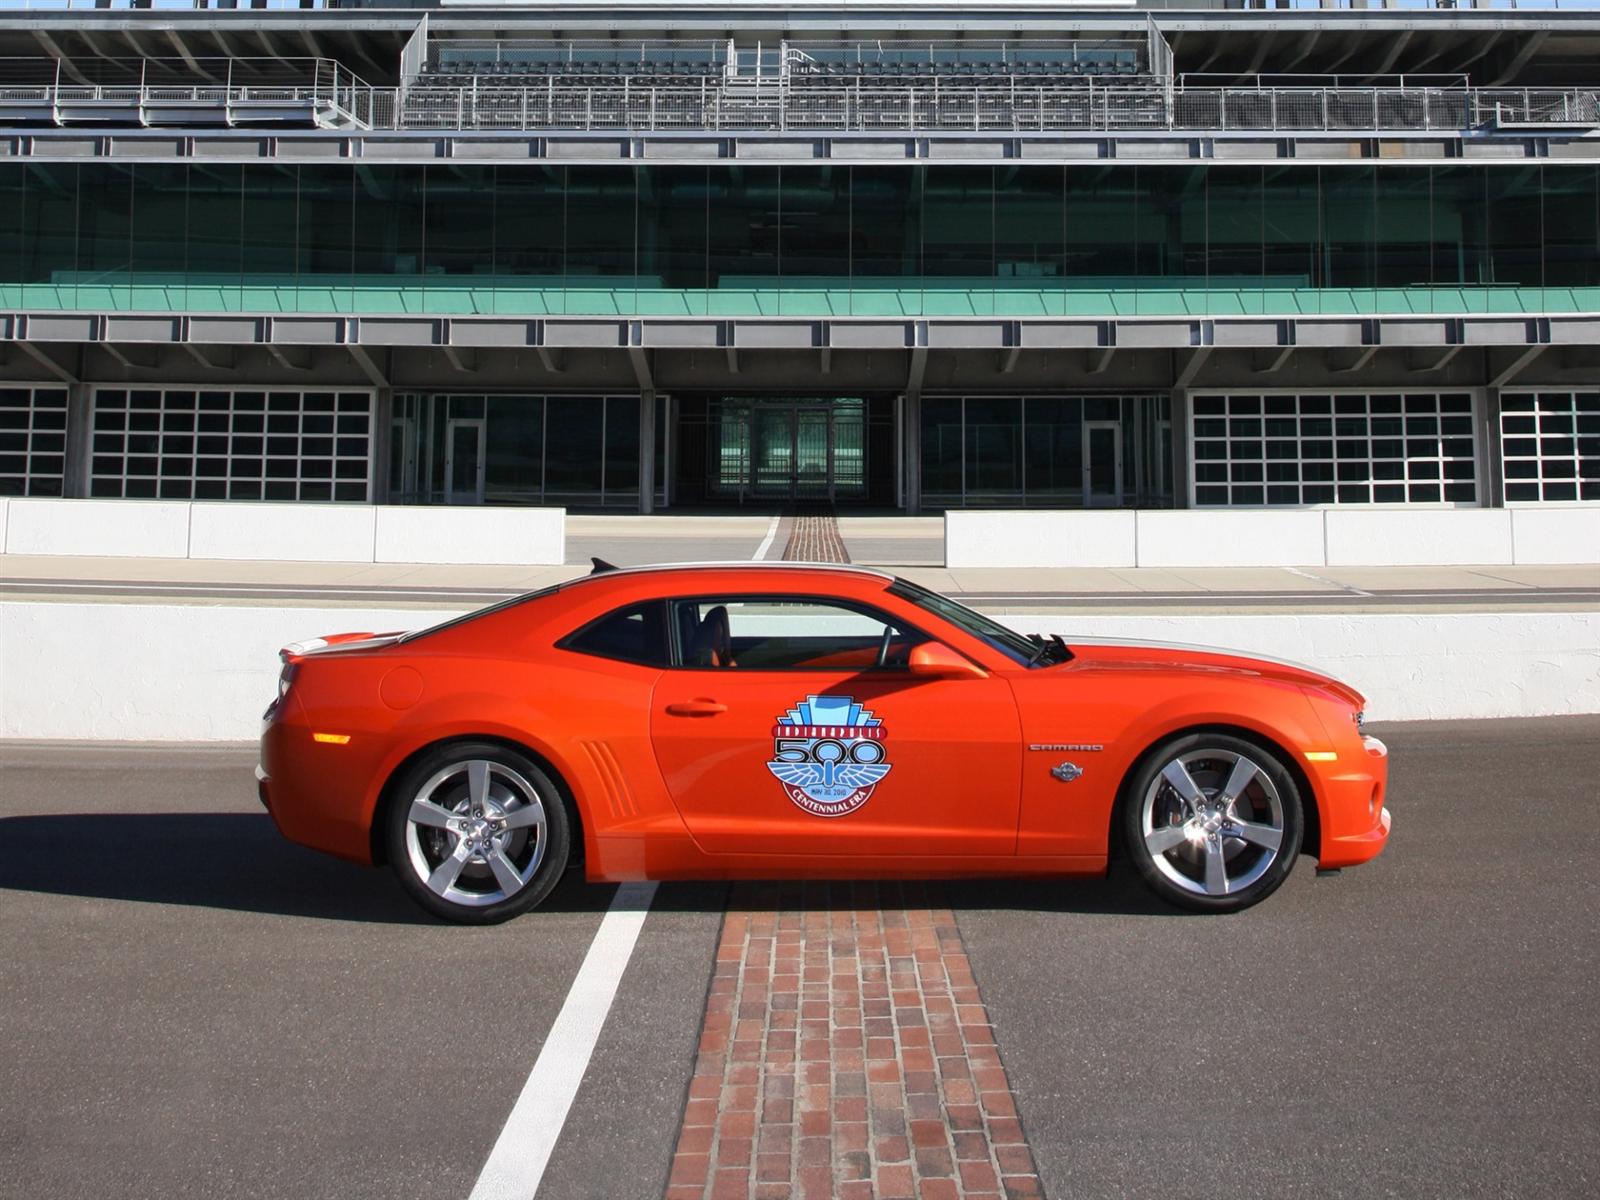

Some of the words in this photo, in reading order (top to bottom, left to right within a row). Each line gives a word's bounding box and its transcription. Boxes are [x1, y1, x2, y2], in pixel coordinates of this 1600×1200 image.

[777, 727, 880, 737] INDIANAPOLIS
[774, 738, 886, 764] 500
[793, 789, 849, 813] CENTENNIAL
[850, 791, 867, 807] ERA
